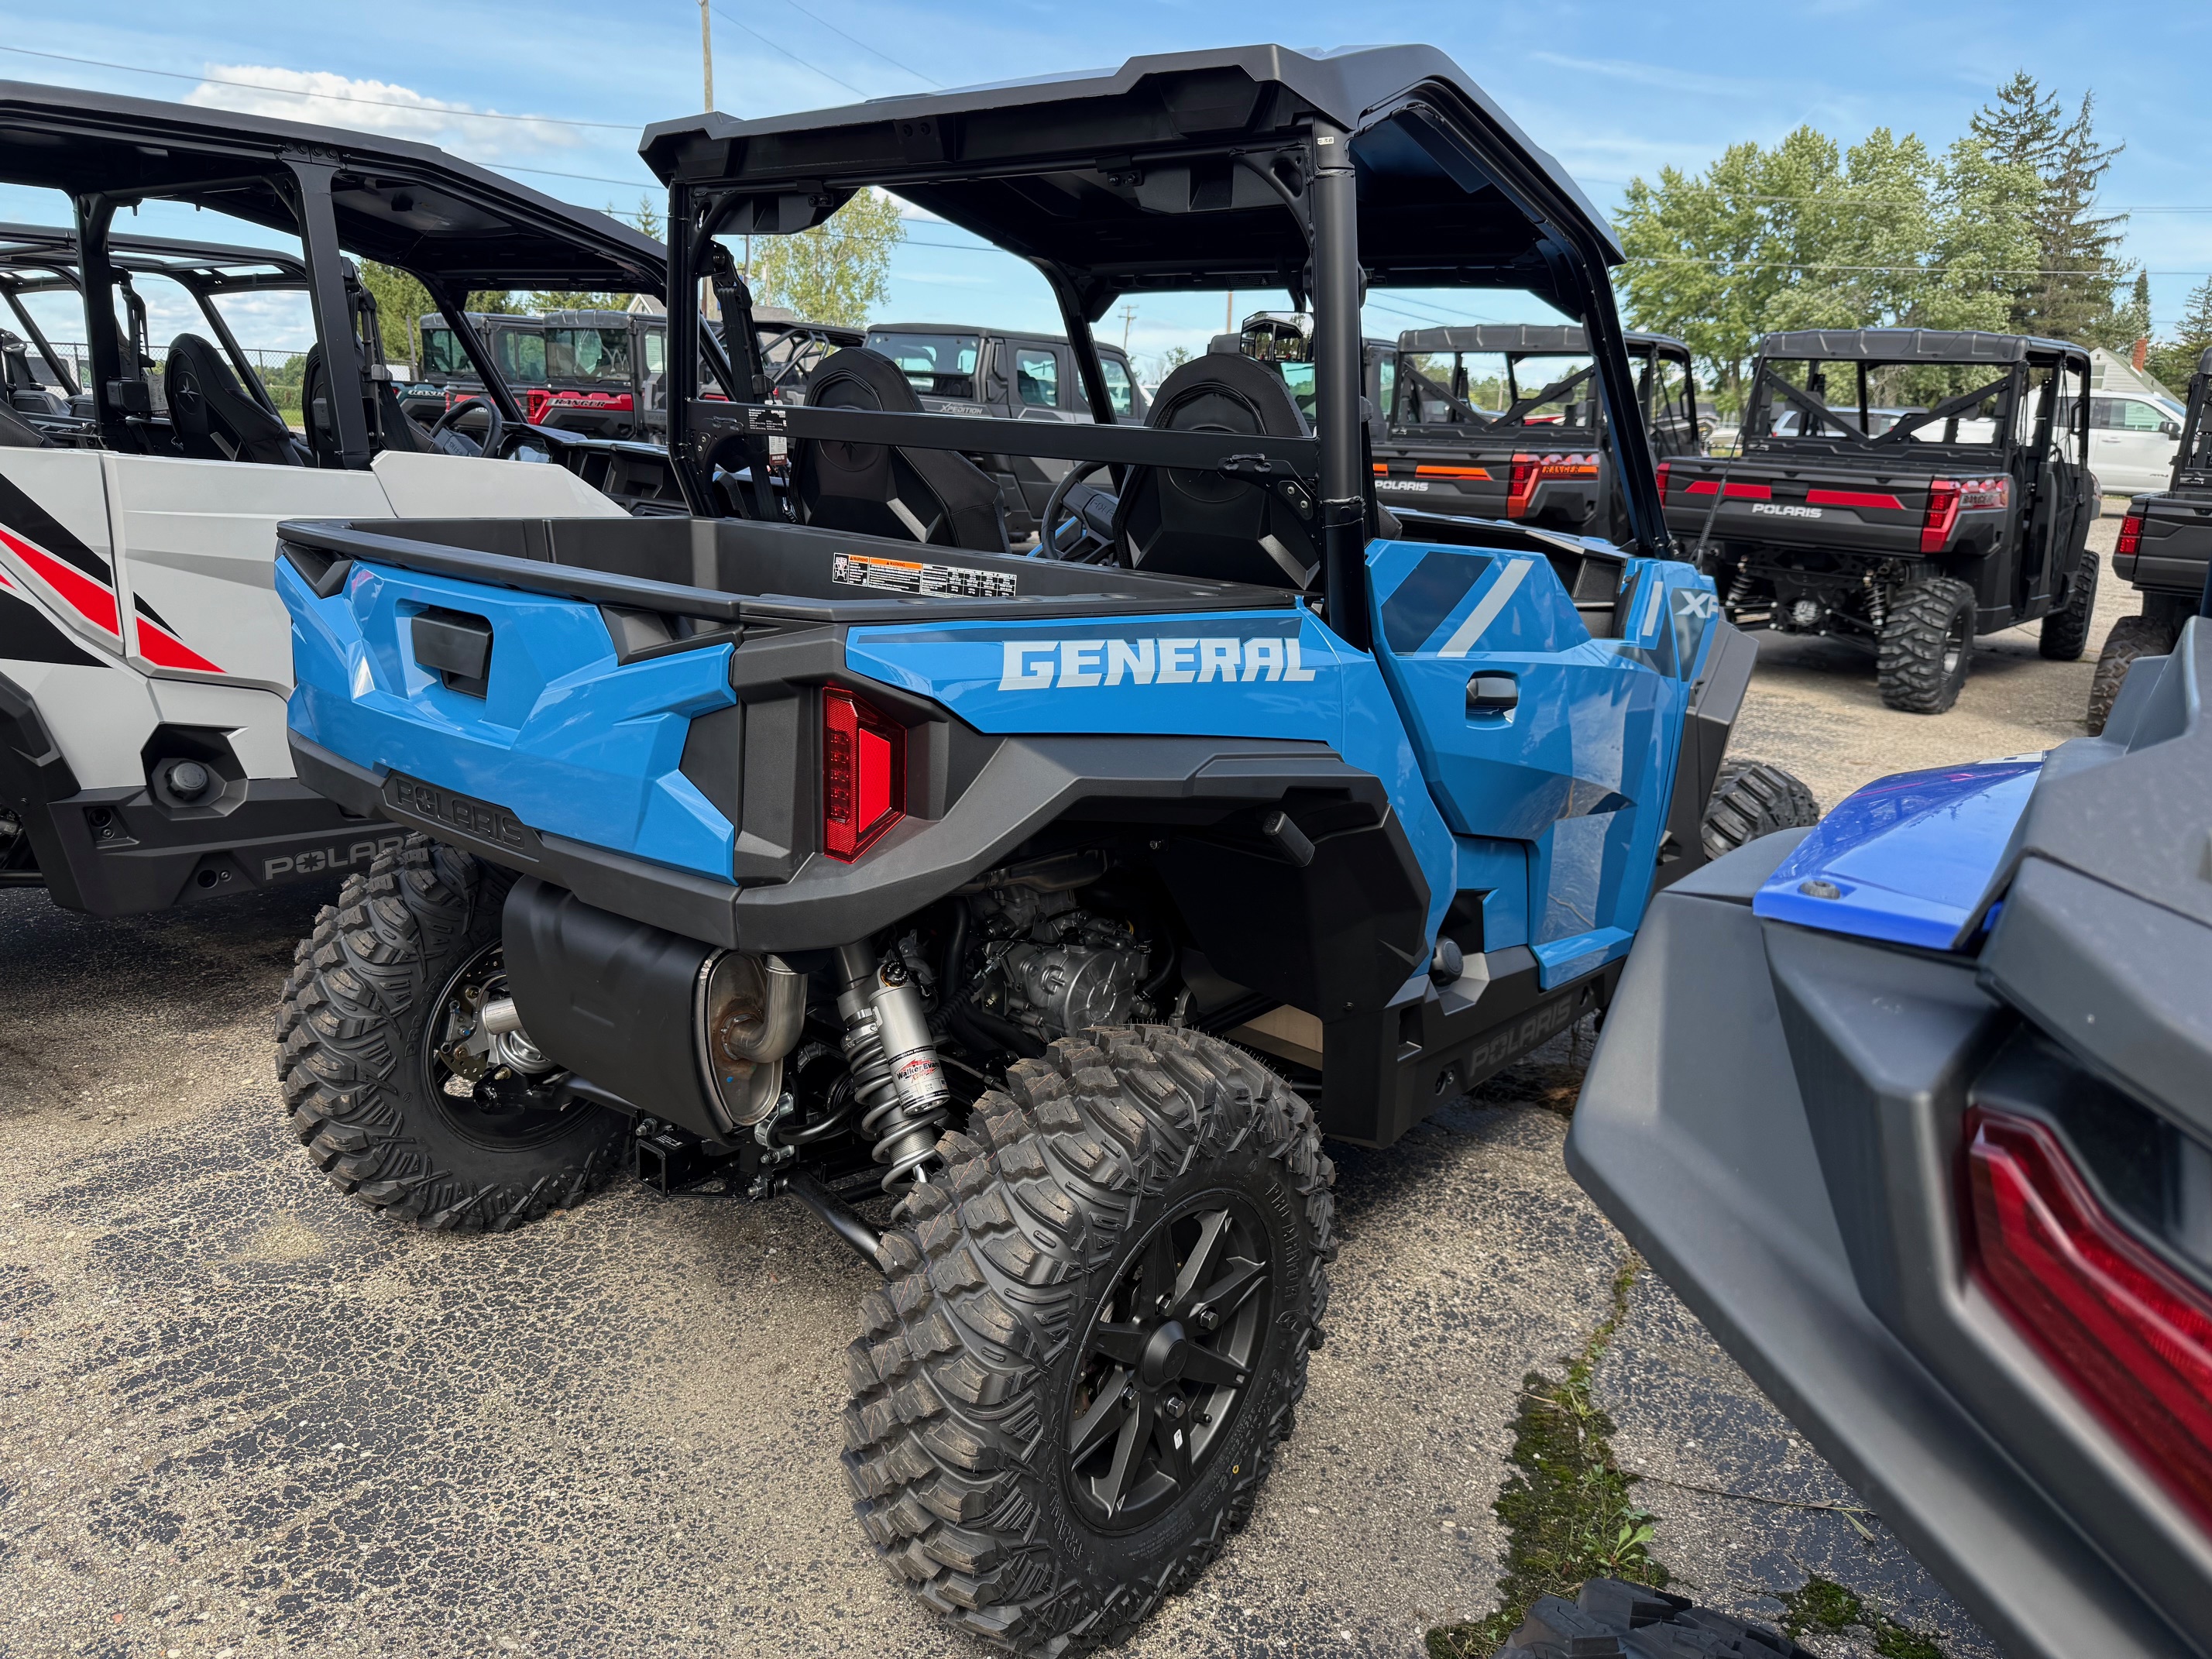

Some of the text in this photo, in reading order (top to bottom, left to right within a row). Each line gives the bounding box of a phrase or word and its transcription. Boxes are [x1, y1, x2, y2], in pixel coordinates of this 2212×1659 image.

[554, 399, 606, 407] RANGER
[939, 403, 983, 414] XPEDITION
[1374, 481, 1428, 492] POLARIS
[1091, 500, 1114, 517] POLA
[1752, 503, 1822, 518] POLARIS
[998, 637, 1316, 691] GENERAL
[396, 778, 525, 850] POLARIS
[263, 836, 405, 881] POLAR
[1471, 994, 1573, 1077] POLARIS
[897, 1066, 922, 1080] Walker
